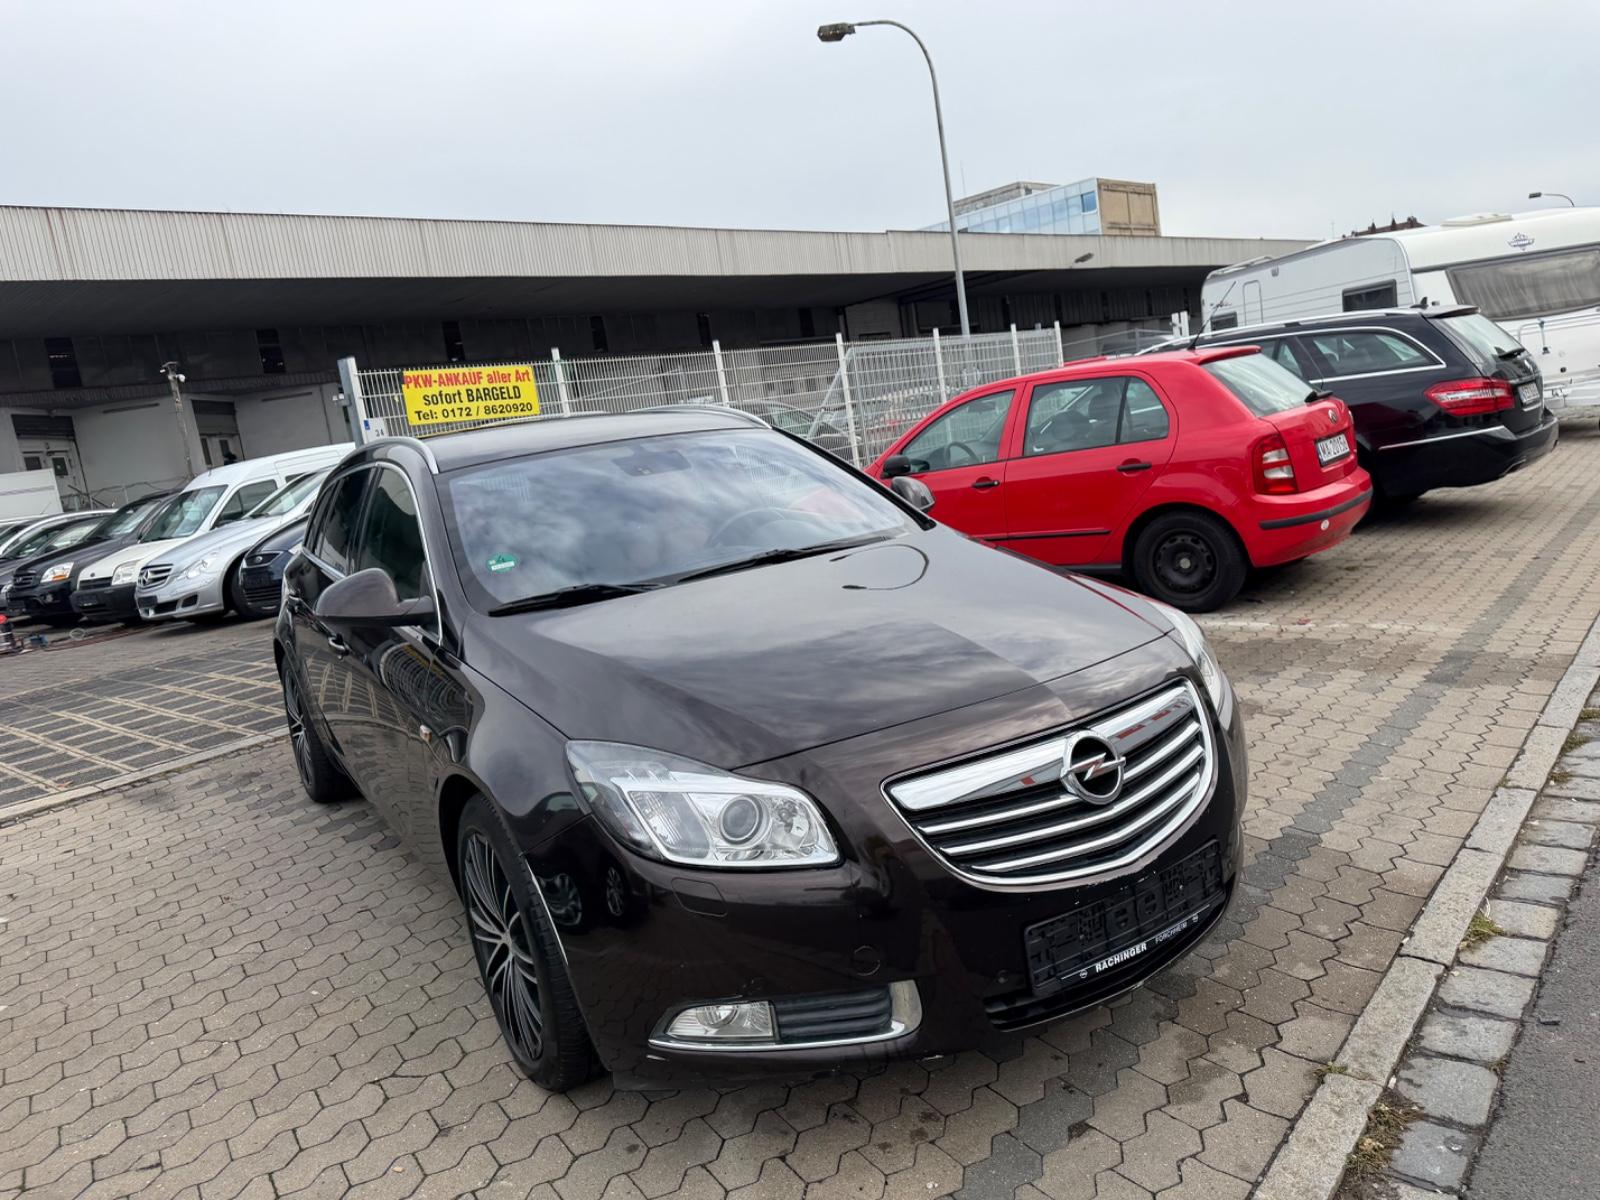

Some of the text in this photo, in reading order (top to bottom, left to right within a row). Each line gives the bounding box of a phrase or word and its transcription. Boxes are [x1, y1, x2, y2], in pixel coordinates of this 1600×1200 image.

[404, 369, 531, 389] PKW-ANKAUF aller Art
[422, 385, 521, 406] sofort BARGELD
[415, 409, 438, 421] Tel:
[441, 406, 472, 419] 0172
[483, 402, 533, 415] 8620920
[1095, 942, 1147, 973] RACHINGER
